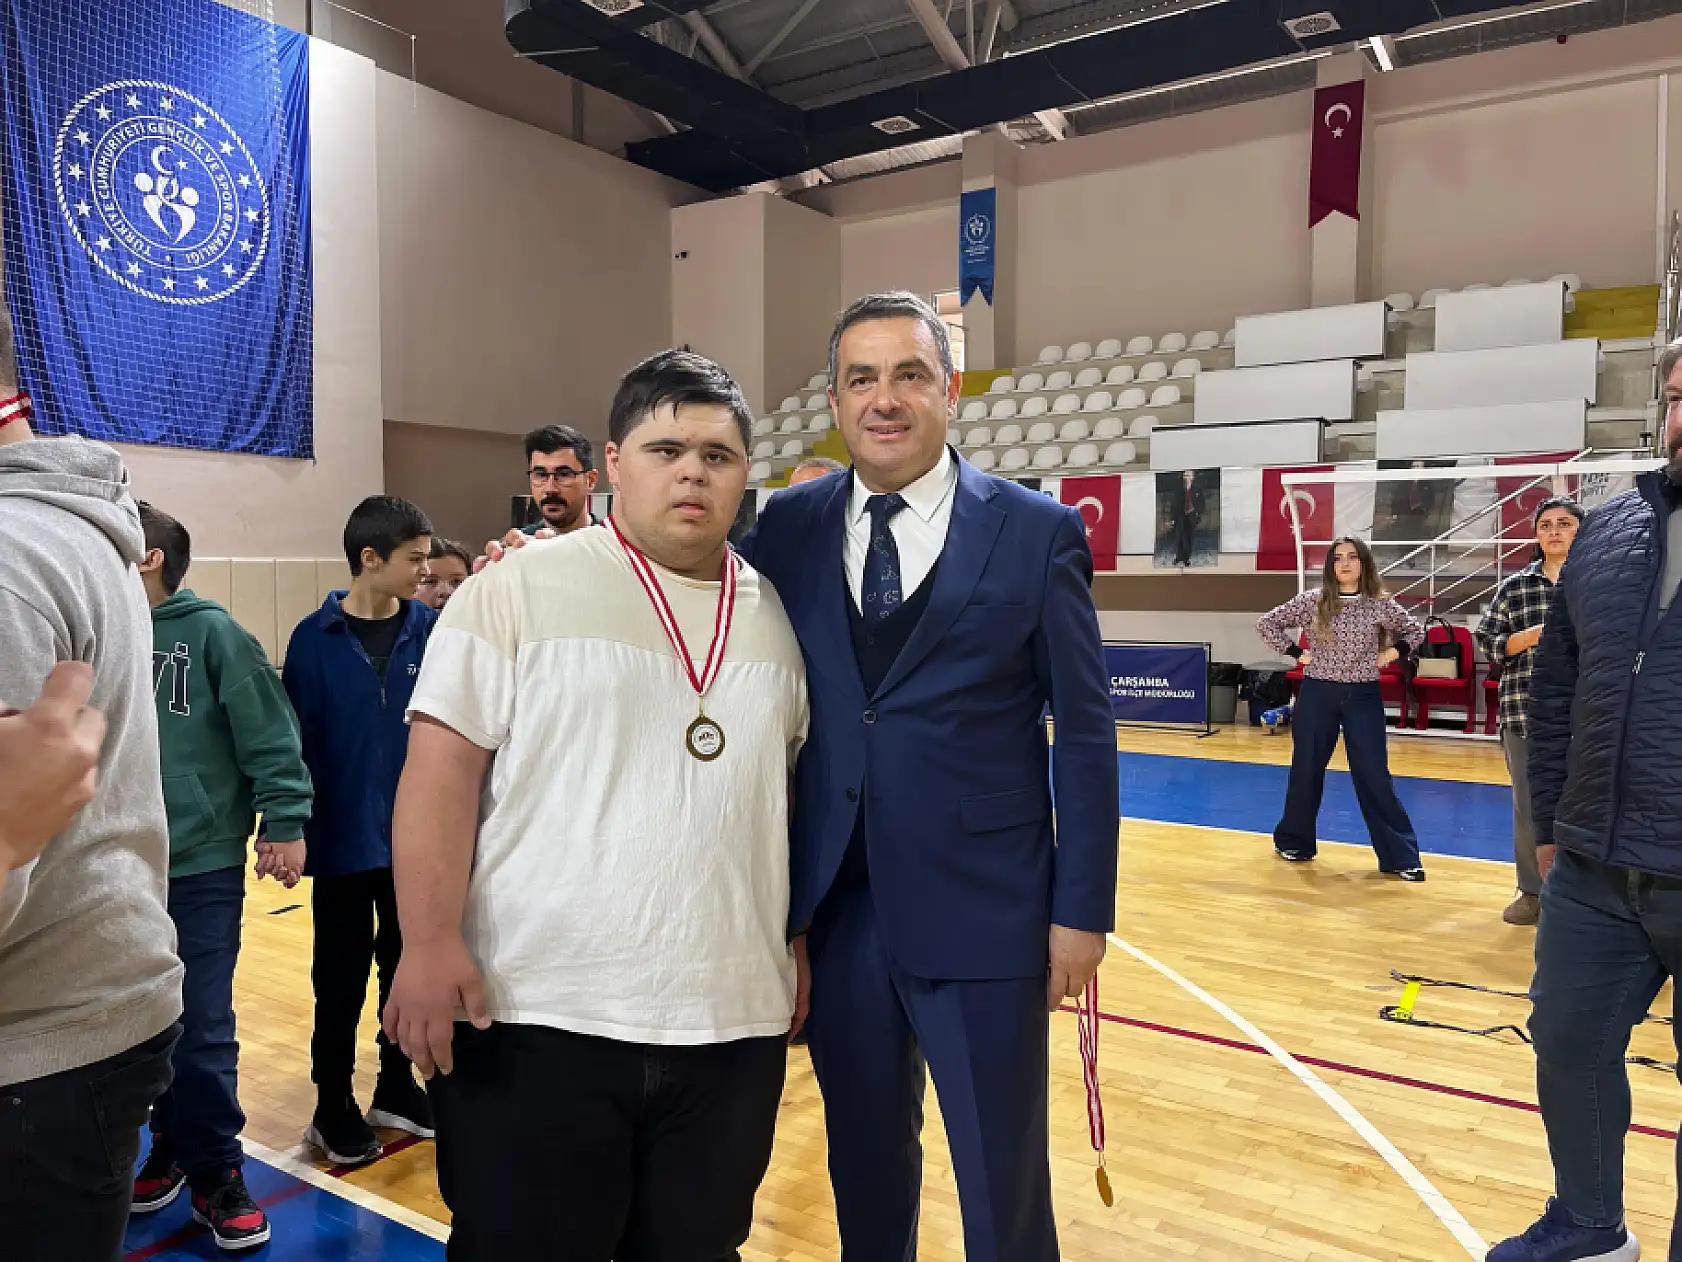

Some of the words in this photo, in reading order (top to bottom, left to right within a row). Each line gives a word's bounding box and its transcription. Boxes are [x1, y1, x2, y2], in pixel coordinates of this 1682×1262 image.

[104, 203, 151, 256] TÜRKİYE
[205, 155, 219, 172] VE
[218, 175, 234, 212] SPOR
[1111, 676, 1169, 688] ÇARŞAMBA
